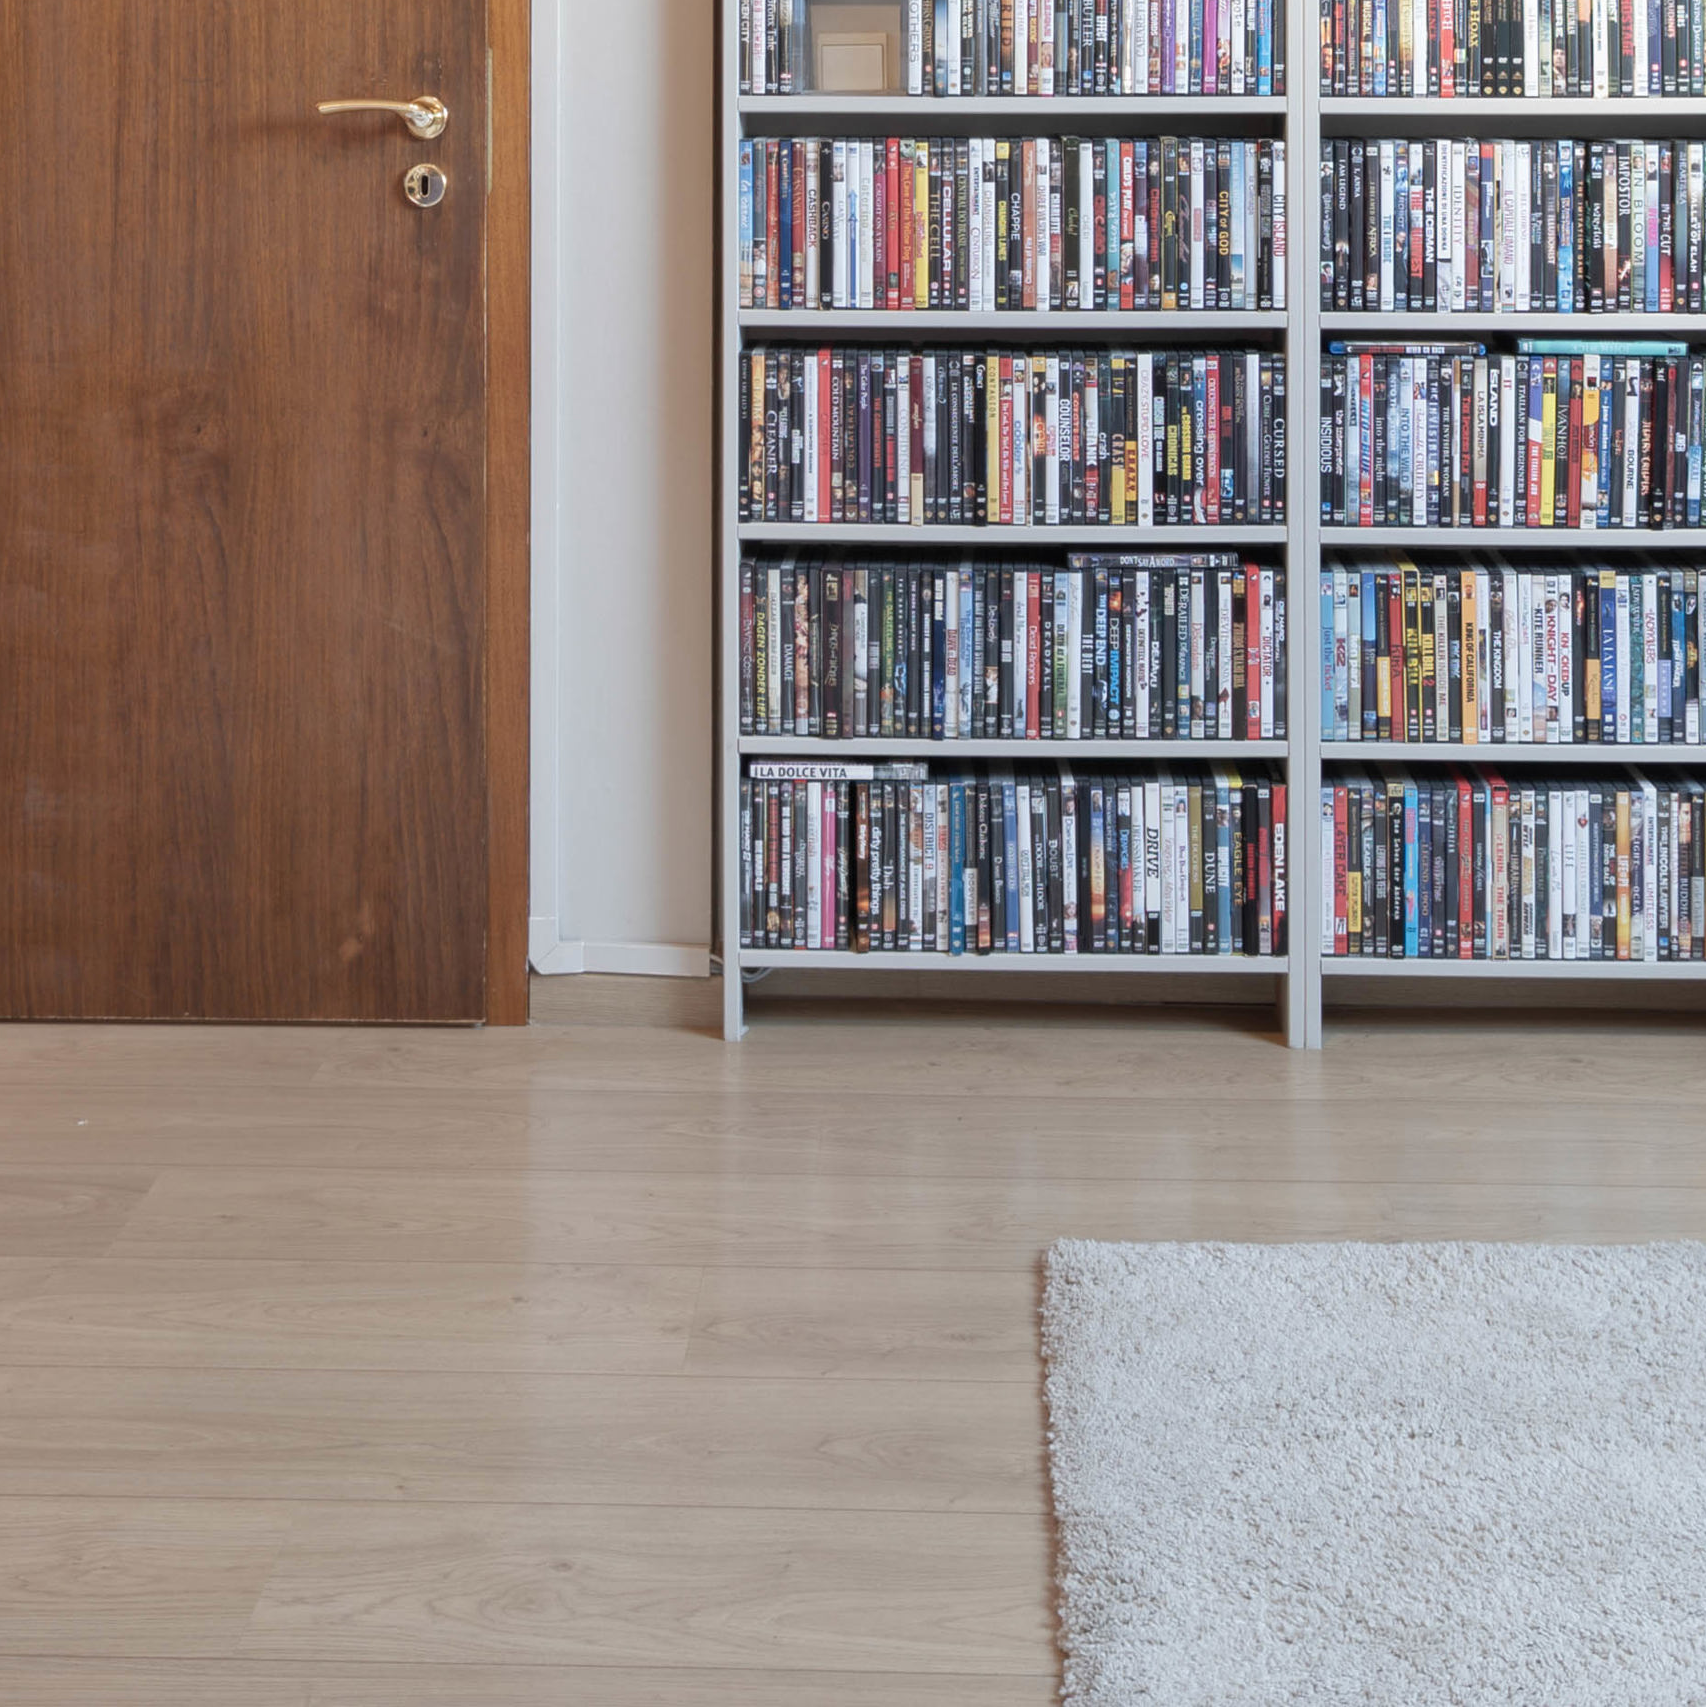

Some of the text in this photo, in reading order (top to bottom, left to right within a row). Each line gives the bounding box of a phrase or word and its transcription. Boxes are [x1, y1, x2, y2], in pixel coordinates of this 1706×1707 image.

[1362, 0, 1371, 36] MUSICAL
[1469, 9, 1480, 47] HOAX
[1453, 185, 1463, 245] IDENTITY
[1618, 156, 1631, 216] IMPOSTOR
[808, 189, 817, 248] CASHBACK
[929, 190, 941, 260] THE CELL
[942, 186, 952, 271] CELLULAR
[1219, 191, 1229, 256] CITY of GOD
[1424, 187, 1435, 263] THE ICEMAN
[1633, 171, 1645, 264] IN BLOOM
[1660, 234, 1671, 256] CUT
[831, 376, 840, 460] COLD MOUNTAIN
[988, 366, 997, 418] CONTAGION
[766, 410, 778, 475] CLEANER
[1059, 399, 1070, 461] COUNSELOR
[1194, 400, 1206, 486] crossing over
[1273, 418, 1284, 478] CURSED
[1320, 417, 1333, 473] INSIDIOUS
[1374, 417, 1385, 482] into the night
[1400, 407, 1411, 483] INTO THE WILD
[756, 612, 767, 717] DAGEN ZONDER LIEF
[784, 643, 793, 681] DAMAGE
[1044, 621, 1052, 691] DEADFALL
[1262, 636, 1272, 677] DICTATOR
[1493, 630, 1502, 688] THE KINGDOM
[1534, 608, 1544, 674] KITE RUNNER
[1546, 615, 1557, 702] KNIGHT DAY
[778, 766, 816, 777] DOLCE
[820, 766, 847, 777] VITA
[924, 813, 935, 859] DISTRICT
[1146, 826, 1159, 879] DRIVE
[869, 827, 882, 915] dirty pretty things
[1204, 852, 1216, 894] DUNE
